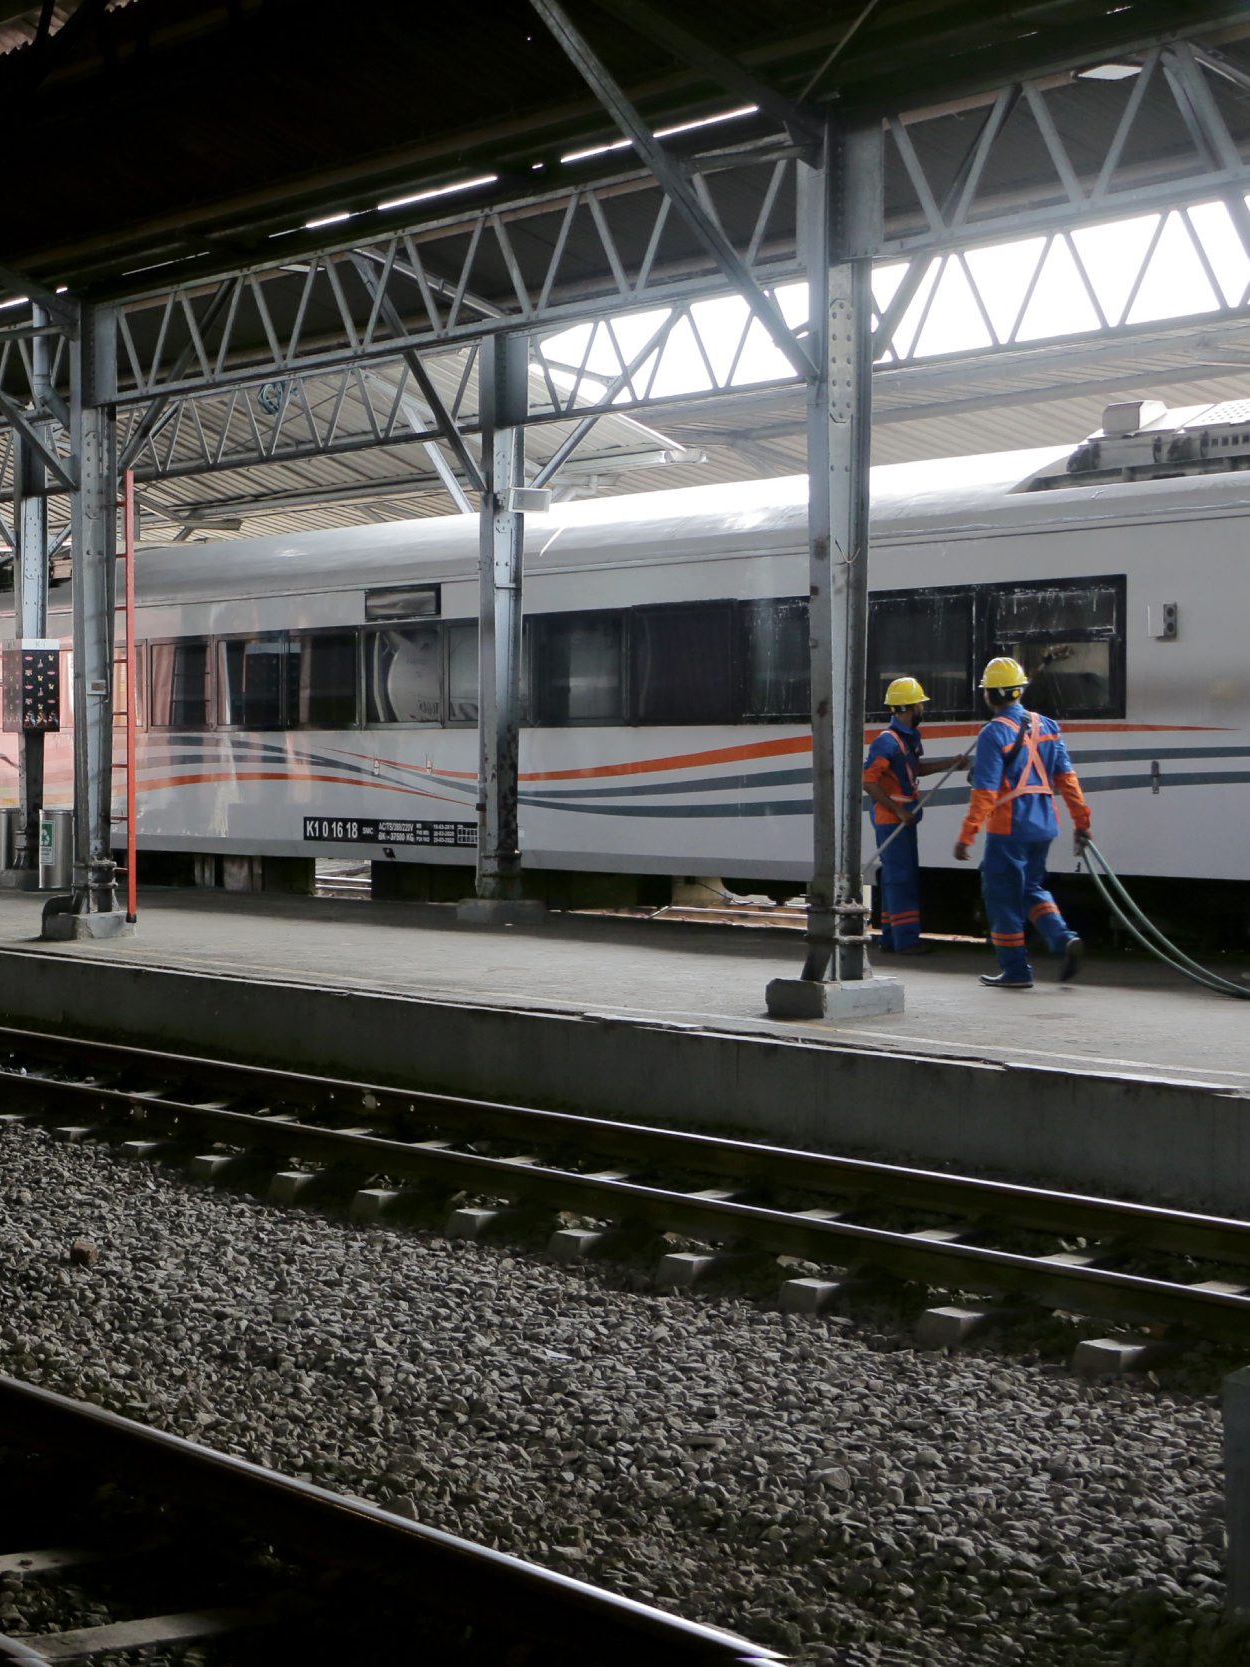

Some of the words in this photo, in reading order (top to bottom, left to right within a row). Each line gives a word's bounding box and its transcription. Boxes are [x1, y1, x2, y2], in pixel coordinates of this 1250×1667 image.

[306, 820, 319, 837] K1
[322, 821, 329, 838] 0
[331, 821, 344, 838] 16
[346, 821, 358, 839] 18
